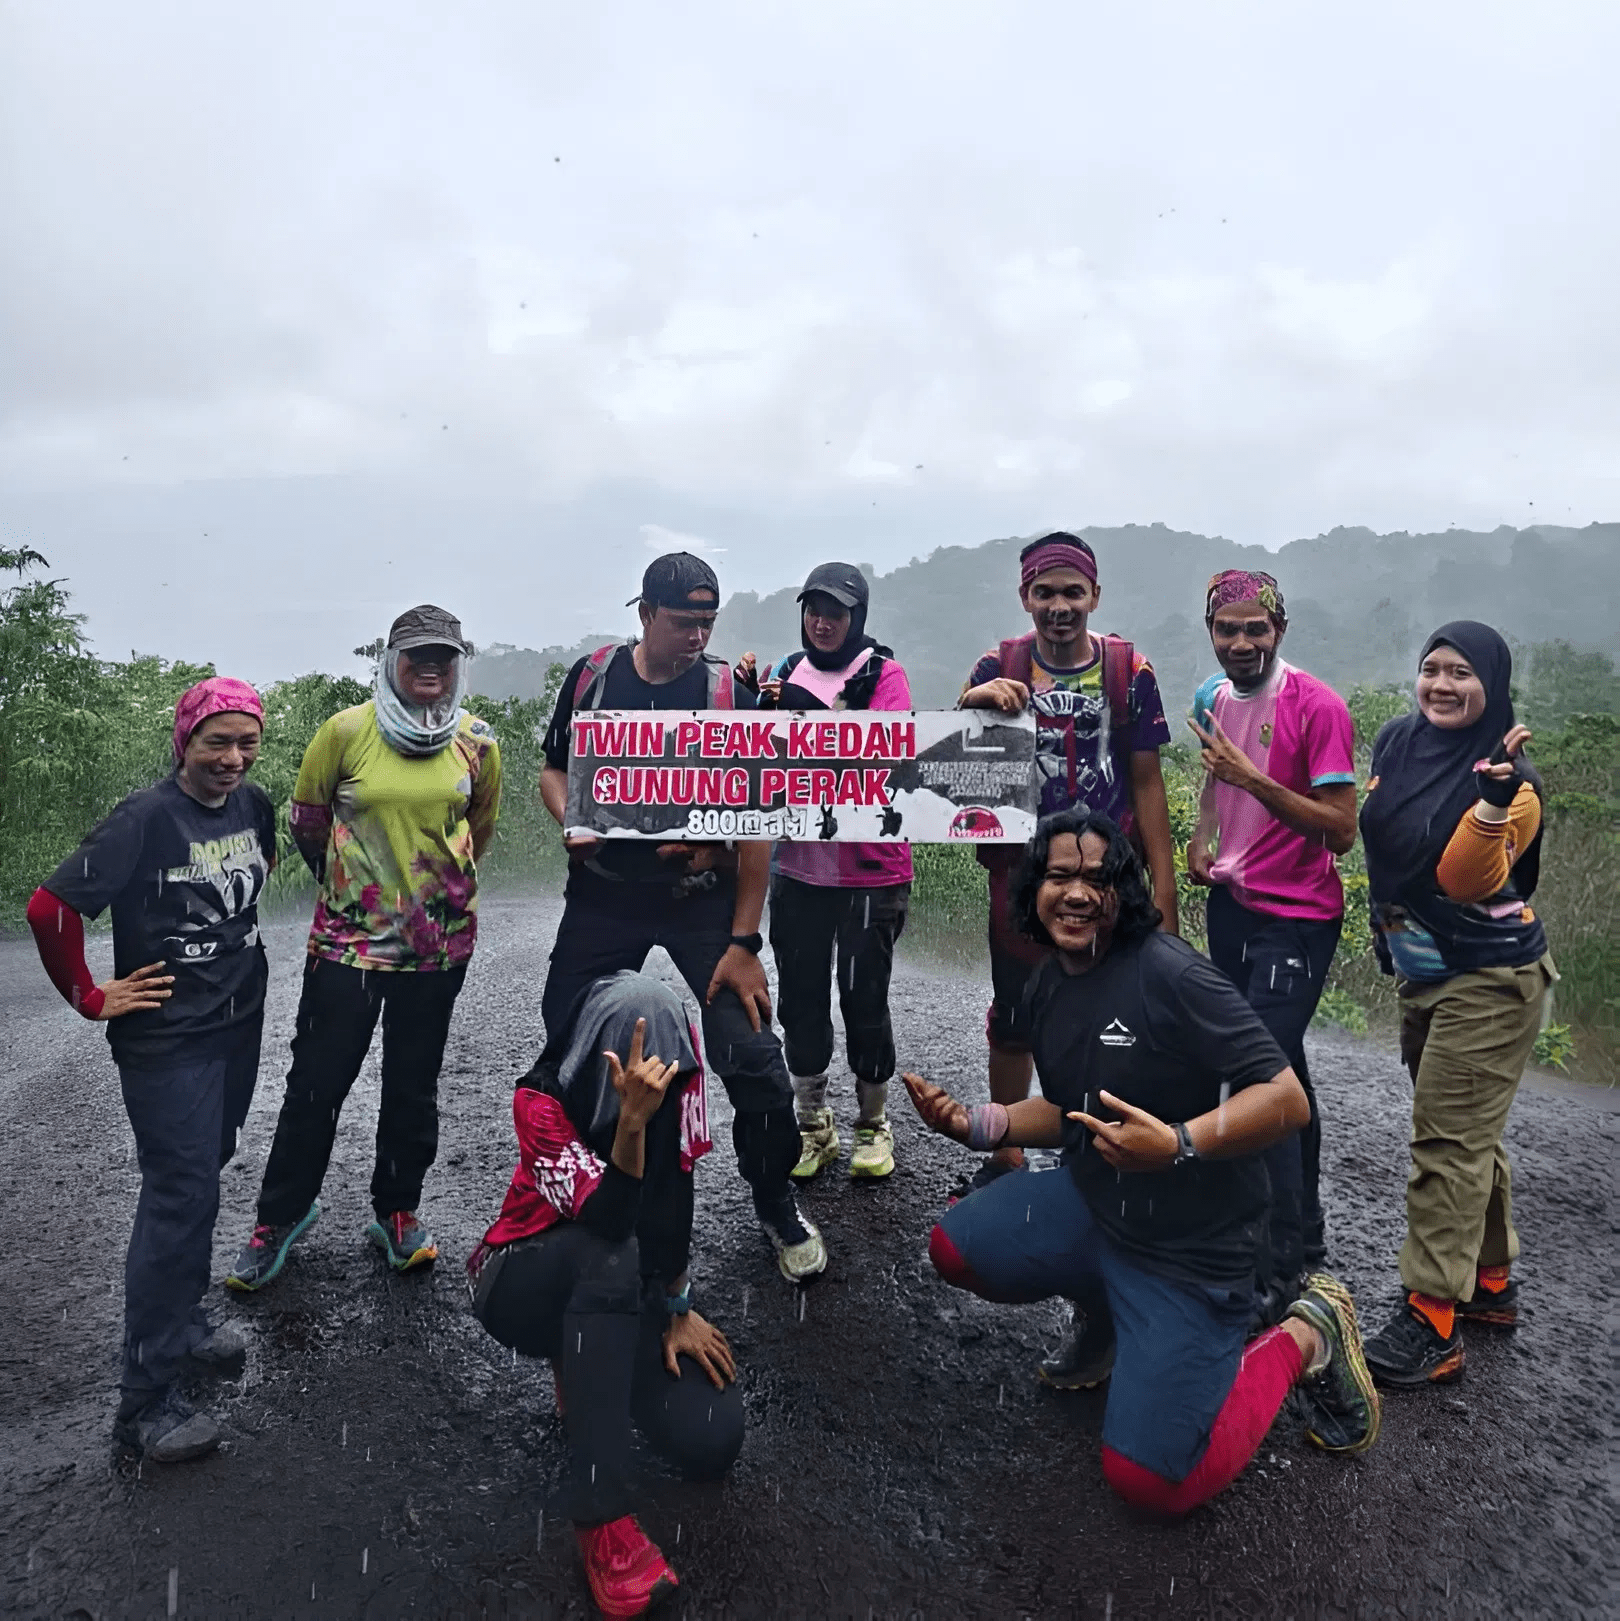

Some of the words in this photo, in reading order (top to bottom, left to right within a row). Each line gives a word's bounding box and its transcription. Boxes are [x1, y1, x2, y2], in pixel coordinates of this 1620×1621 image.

[573, 721, 665, 757] TWIN
[675, 721, 778, 759] PEAK
[787, 721, 916, 760] KEDAH
[592, 766, 749, 805] GUNUNG
[760, 768, 891, 806] PERAK
